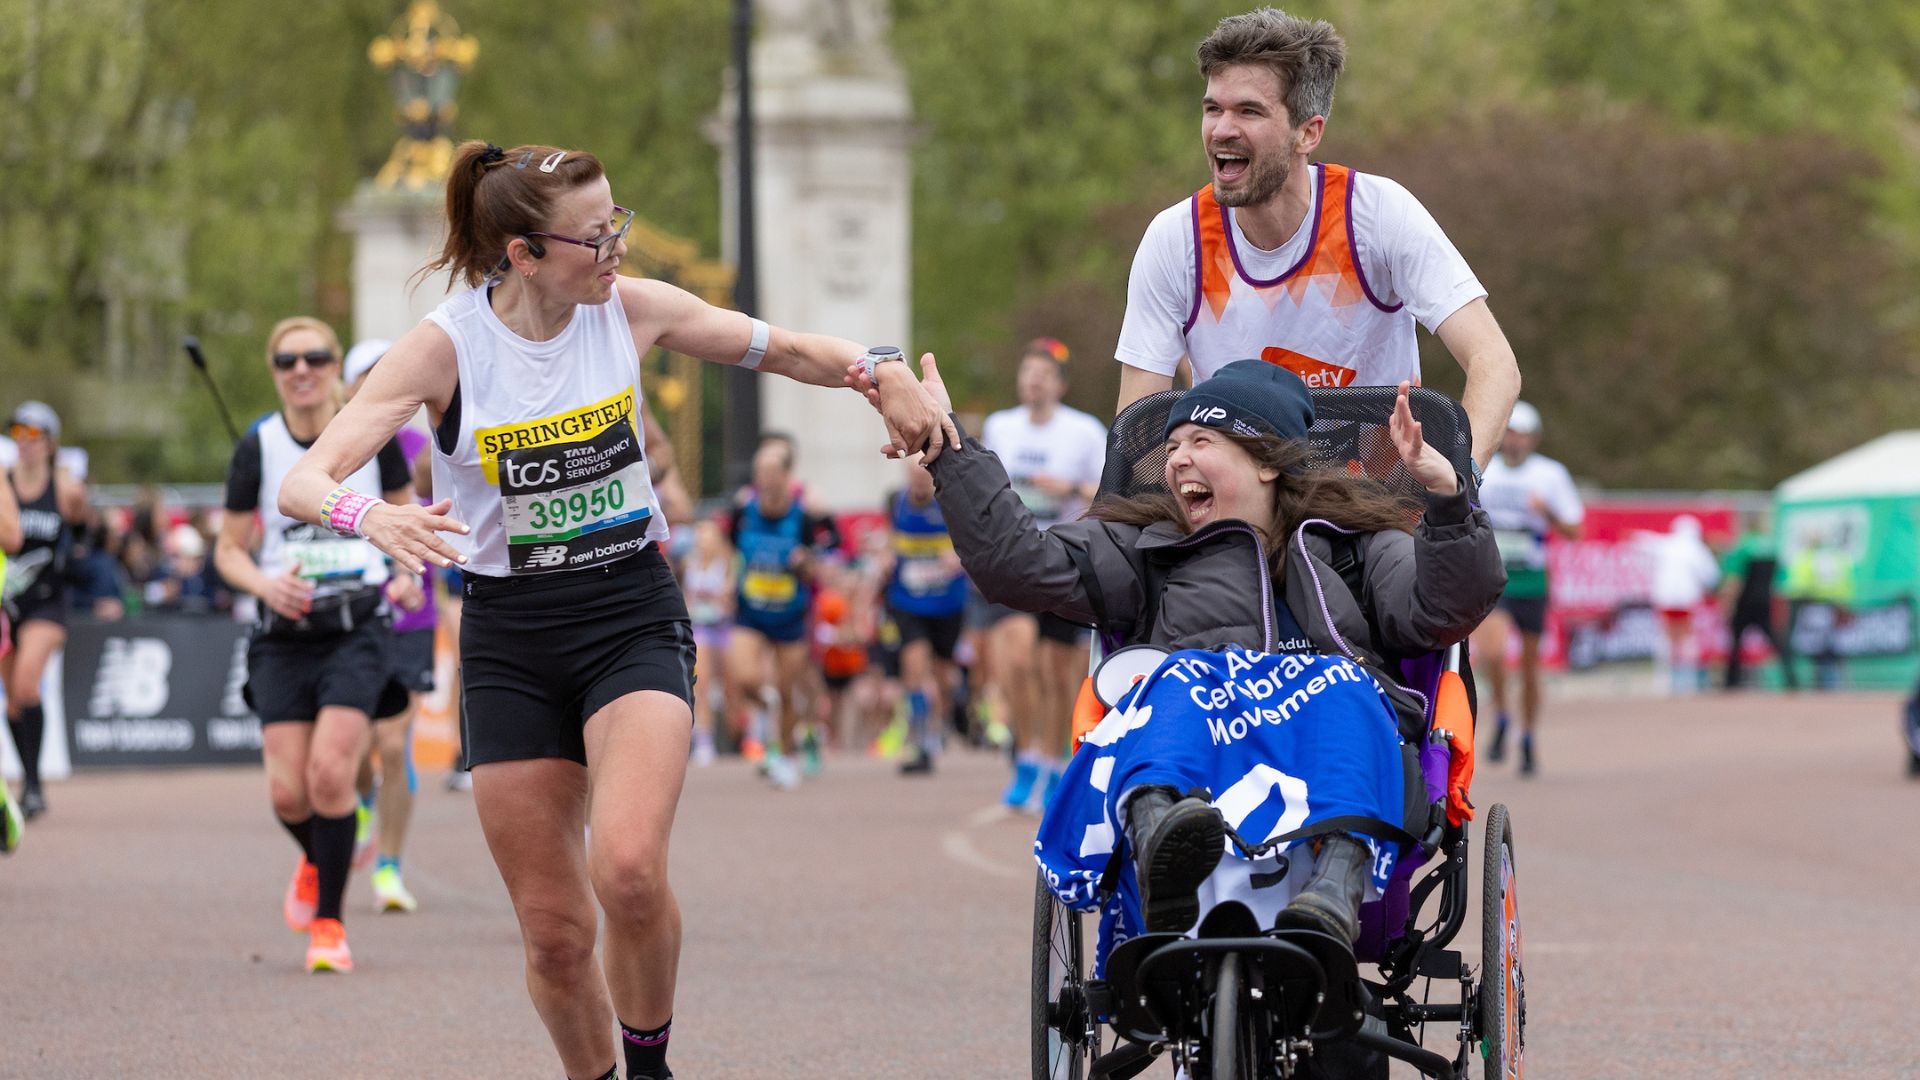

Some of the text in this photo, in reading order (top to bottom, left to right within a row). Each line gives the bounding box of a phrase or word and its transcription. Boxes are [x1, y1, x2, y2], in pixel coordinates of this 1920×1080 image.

[1301, 368, 1344, 388] iety
[484, 395, 632, 455] SPRINGFIELD
[1190, 404, 1227, 422] UP
[563, 446, 596, 458] TATA
[564, 437, 630, 470] CONSULTANCY
[506, 458, 561, 489] tcs
[565, 460, 612, 480] SERVICES
[528, 479, 625, 530] 39950
[569, 536, 644, 565] new balance
[1278, 637, 1318, 650] Adul
[1161, 657, 1217, 684] Th
[1206, 660, 1361, 746] Movement
